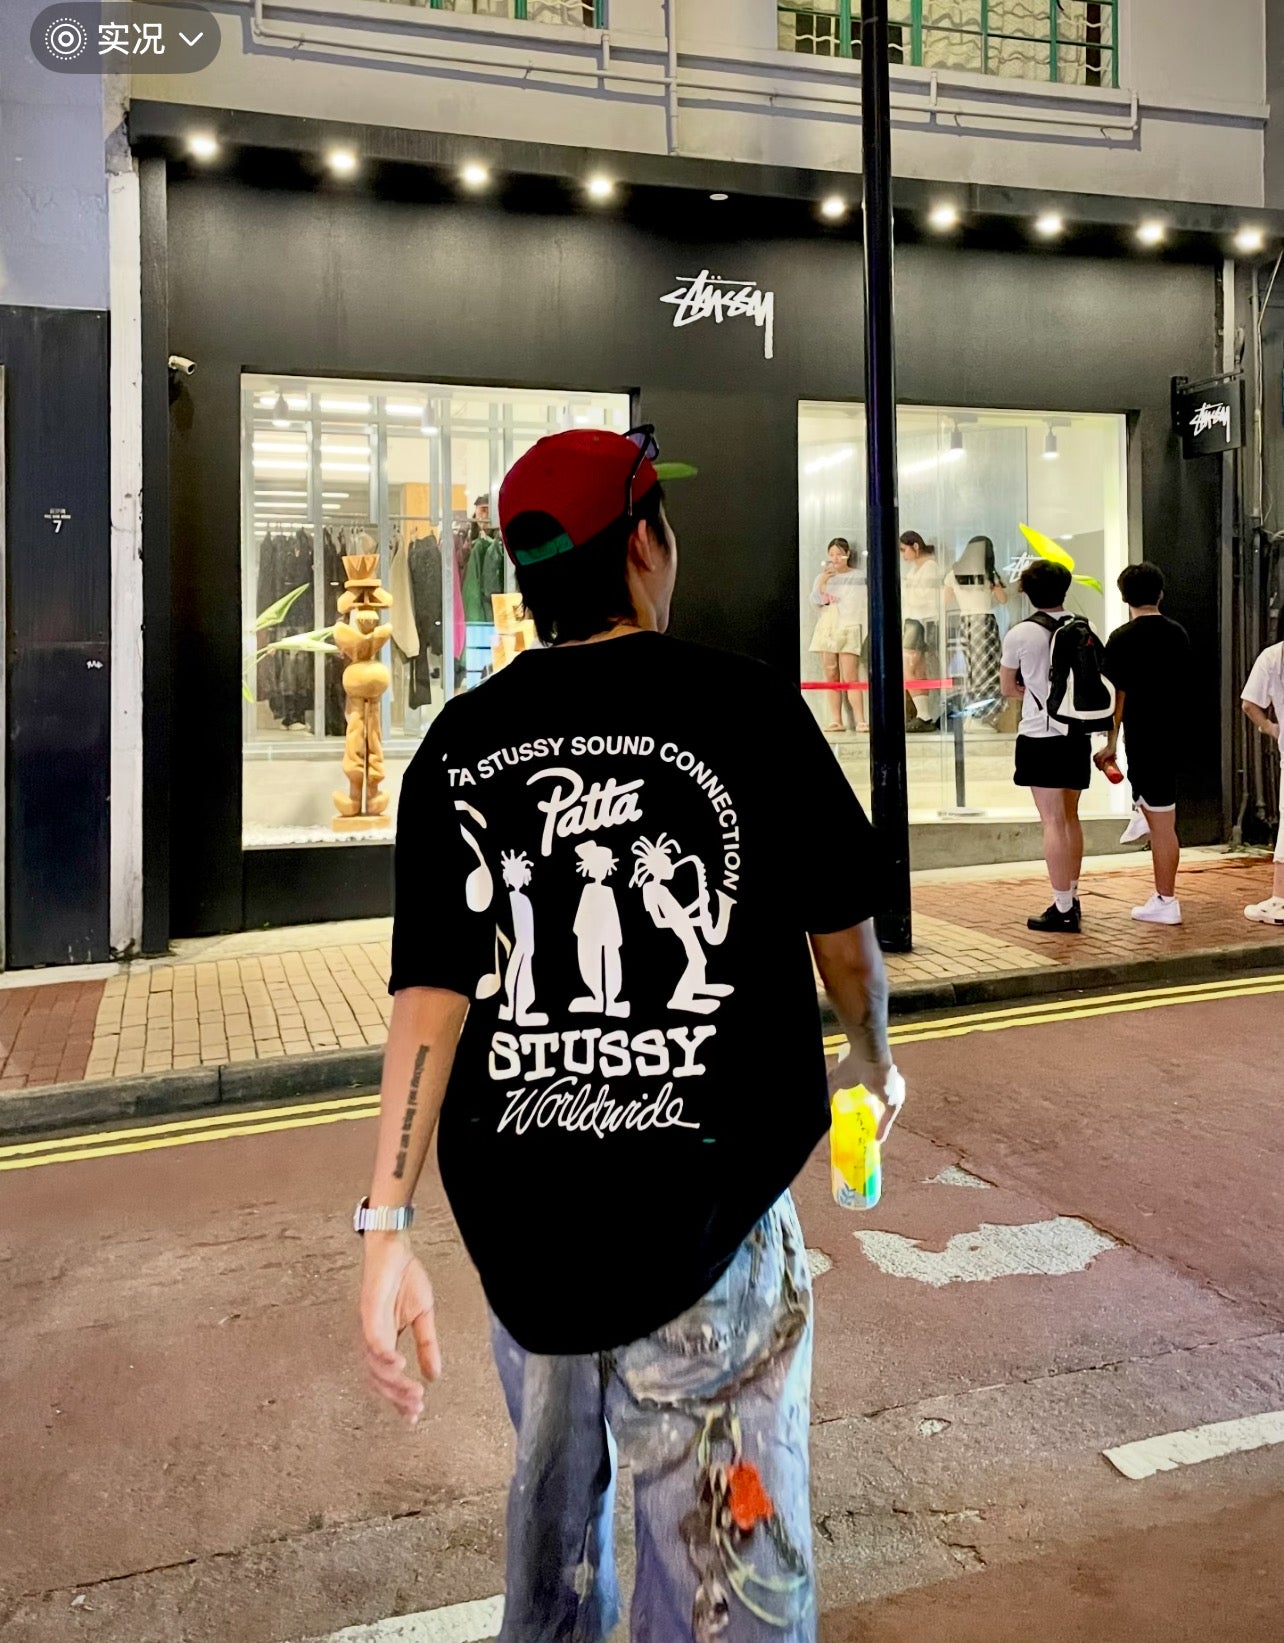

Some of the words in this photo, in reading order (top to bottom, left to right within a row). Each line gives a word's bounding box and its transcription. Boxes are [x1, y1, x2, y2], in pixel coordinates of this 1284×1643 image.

[53, 519, 62, 533] 7
[477, 737, 564, 779] STUSSY
[570, 735, 655, 756] SOUND
[660, 742, 741, 891] CONNECTION
[526, 767, 645, 857] Patta
[489, 1025, 717, 1081] STUSSY
[497, 1076, 700, 1139] Worldwide
